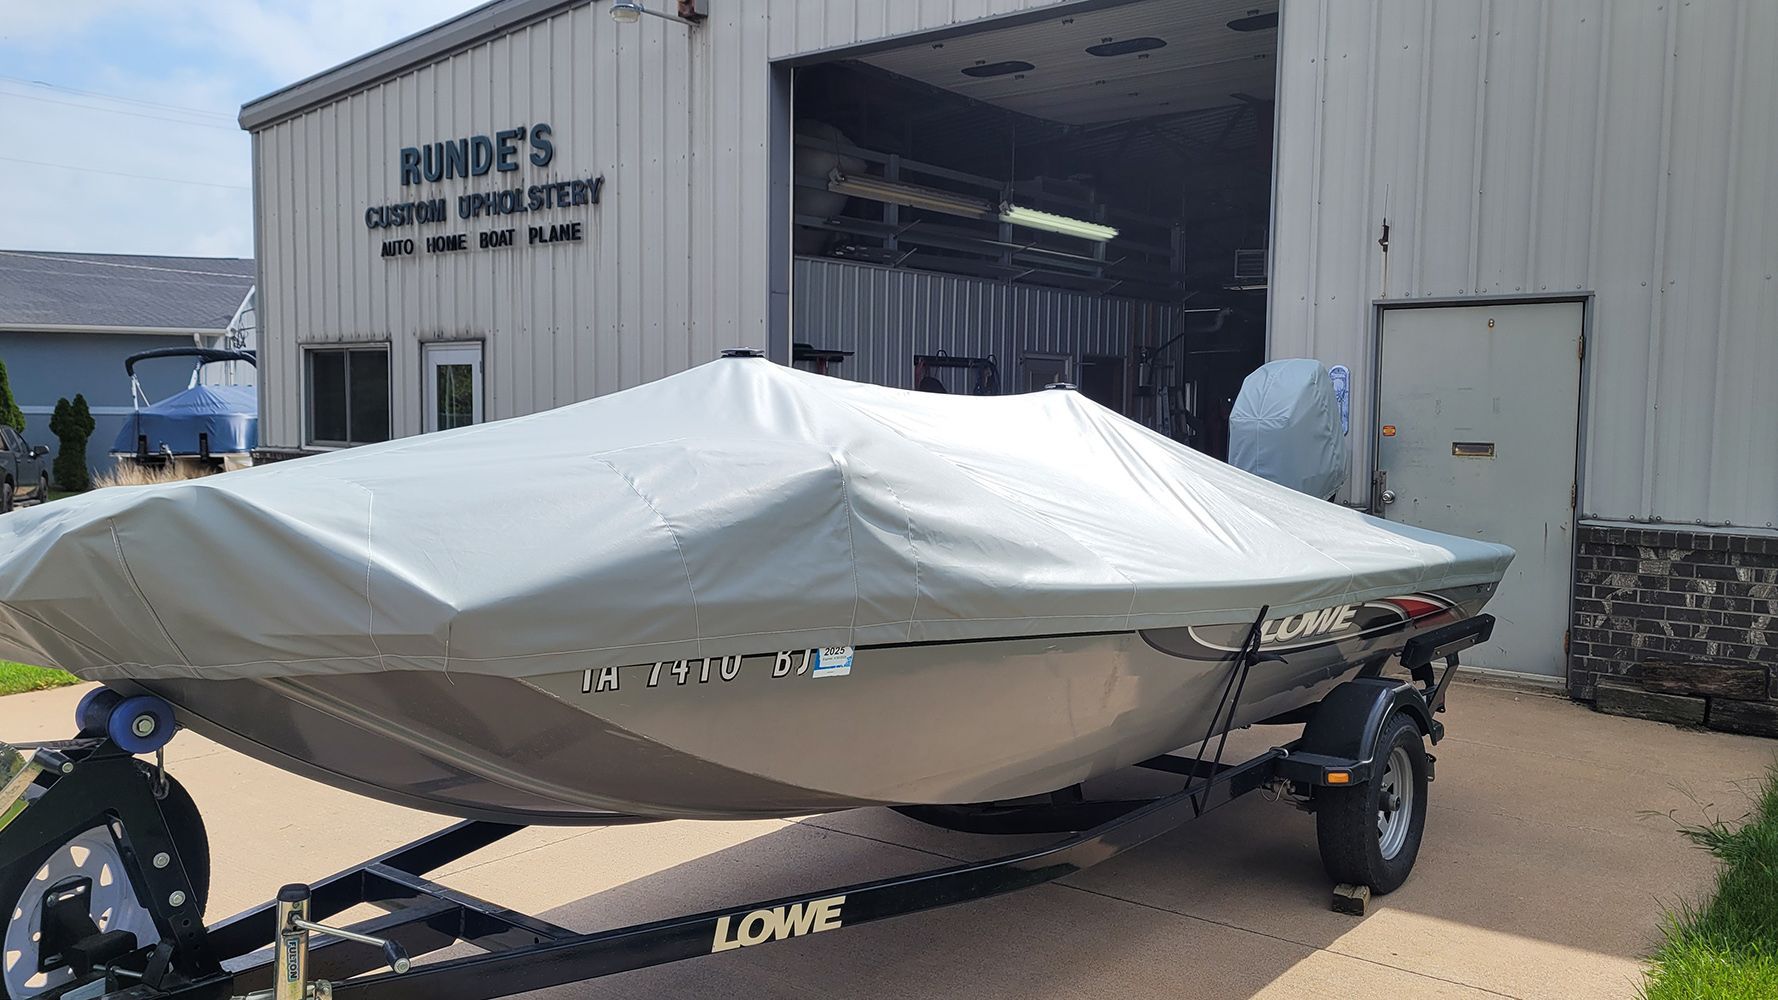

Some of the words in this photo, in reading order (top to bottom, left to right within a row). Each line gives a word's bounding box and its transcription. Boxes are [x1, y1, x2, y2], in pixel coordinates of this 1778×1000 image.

[400, 123, 553, 186] RUNDE'S
[365, 198, 447, 229] CUSTOM
[457, 176, 604, 219] UPHOLSTERY
[381, 238, 414, 257] AUTO
[426, 233, 467, 253] HOME
[479, 228, 515, 248] BOAT
[528, 222, 581, 244] PLANE
[1260, 604, 1358, 643] LOWE
[824, 646, 845, 656] 2025
[711, 895, 846, 952] LOWE
[289, 941, 298, 979] FULTON
